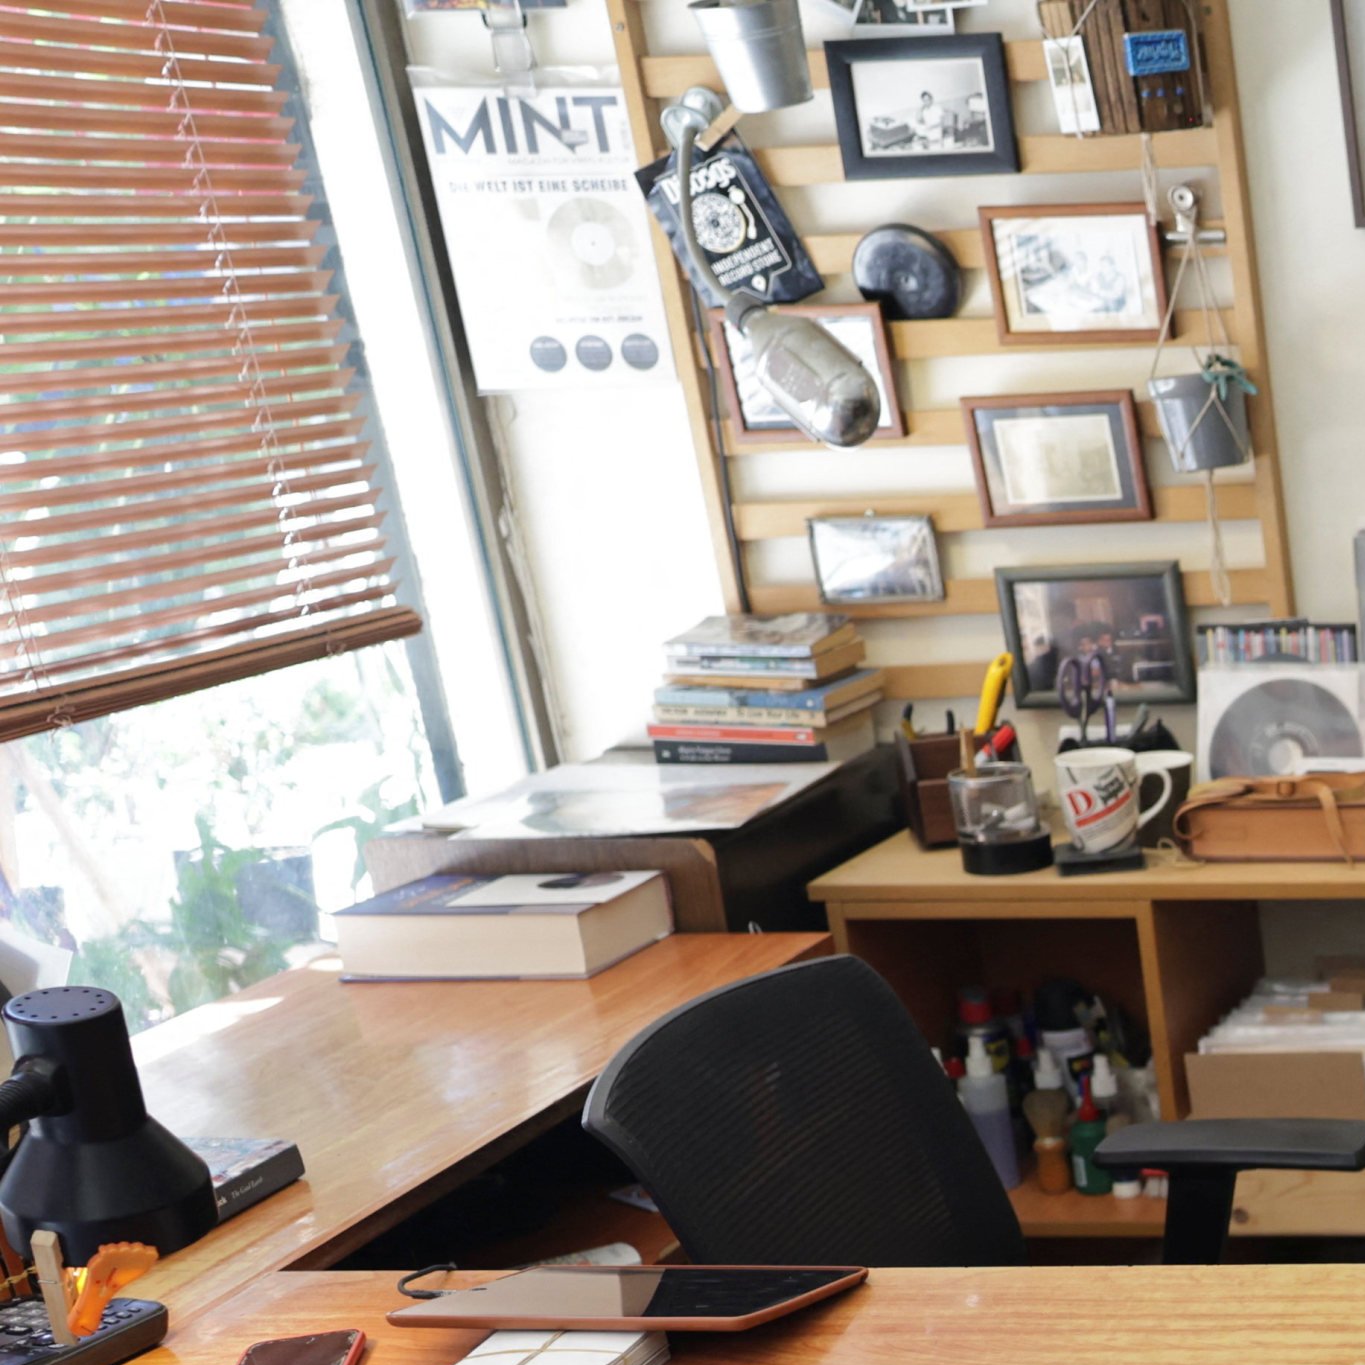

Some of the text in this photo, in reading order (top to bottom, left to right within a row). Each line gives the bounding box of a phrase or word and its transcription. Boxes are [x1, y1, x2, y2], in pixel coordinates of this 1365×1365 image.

[424, 96, 618, 155] MINT
[476, 179, 508, 192] WELT
[512, 179, 533, 192] IST
[539, 179, 567, 192] EINE
[572, 178, 628, 192] SCHEIBE
